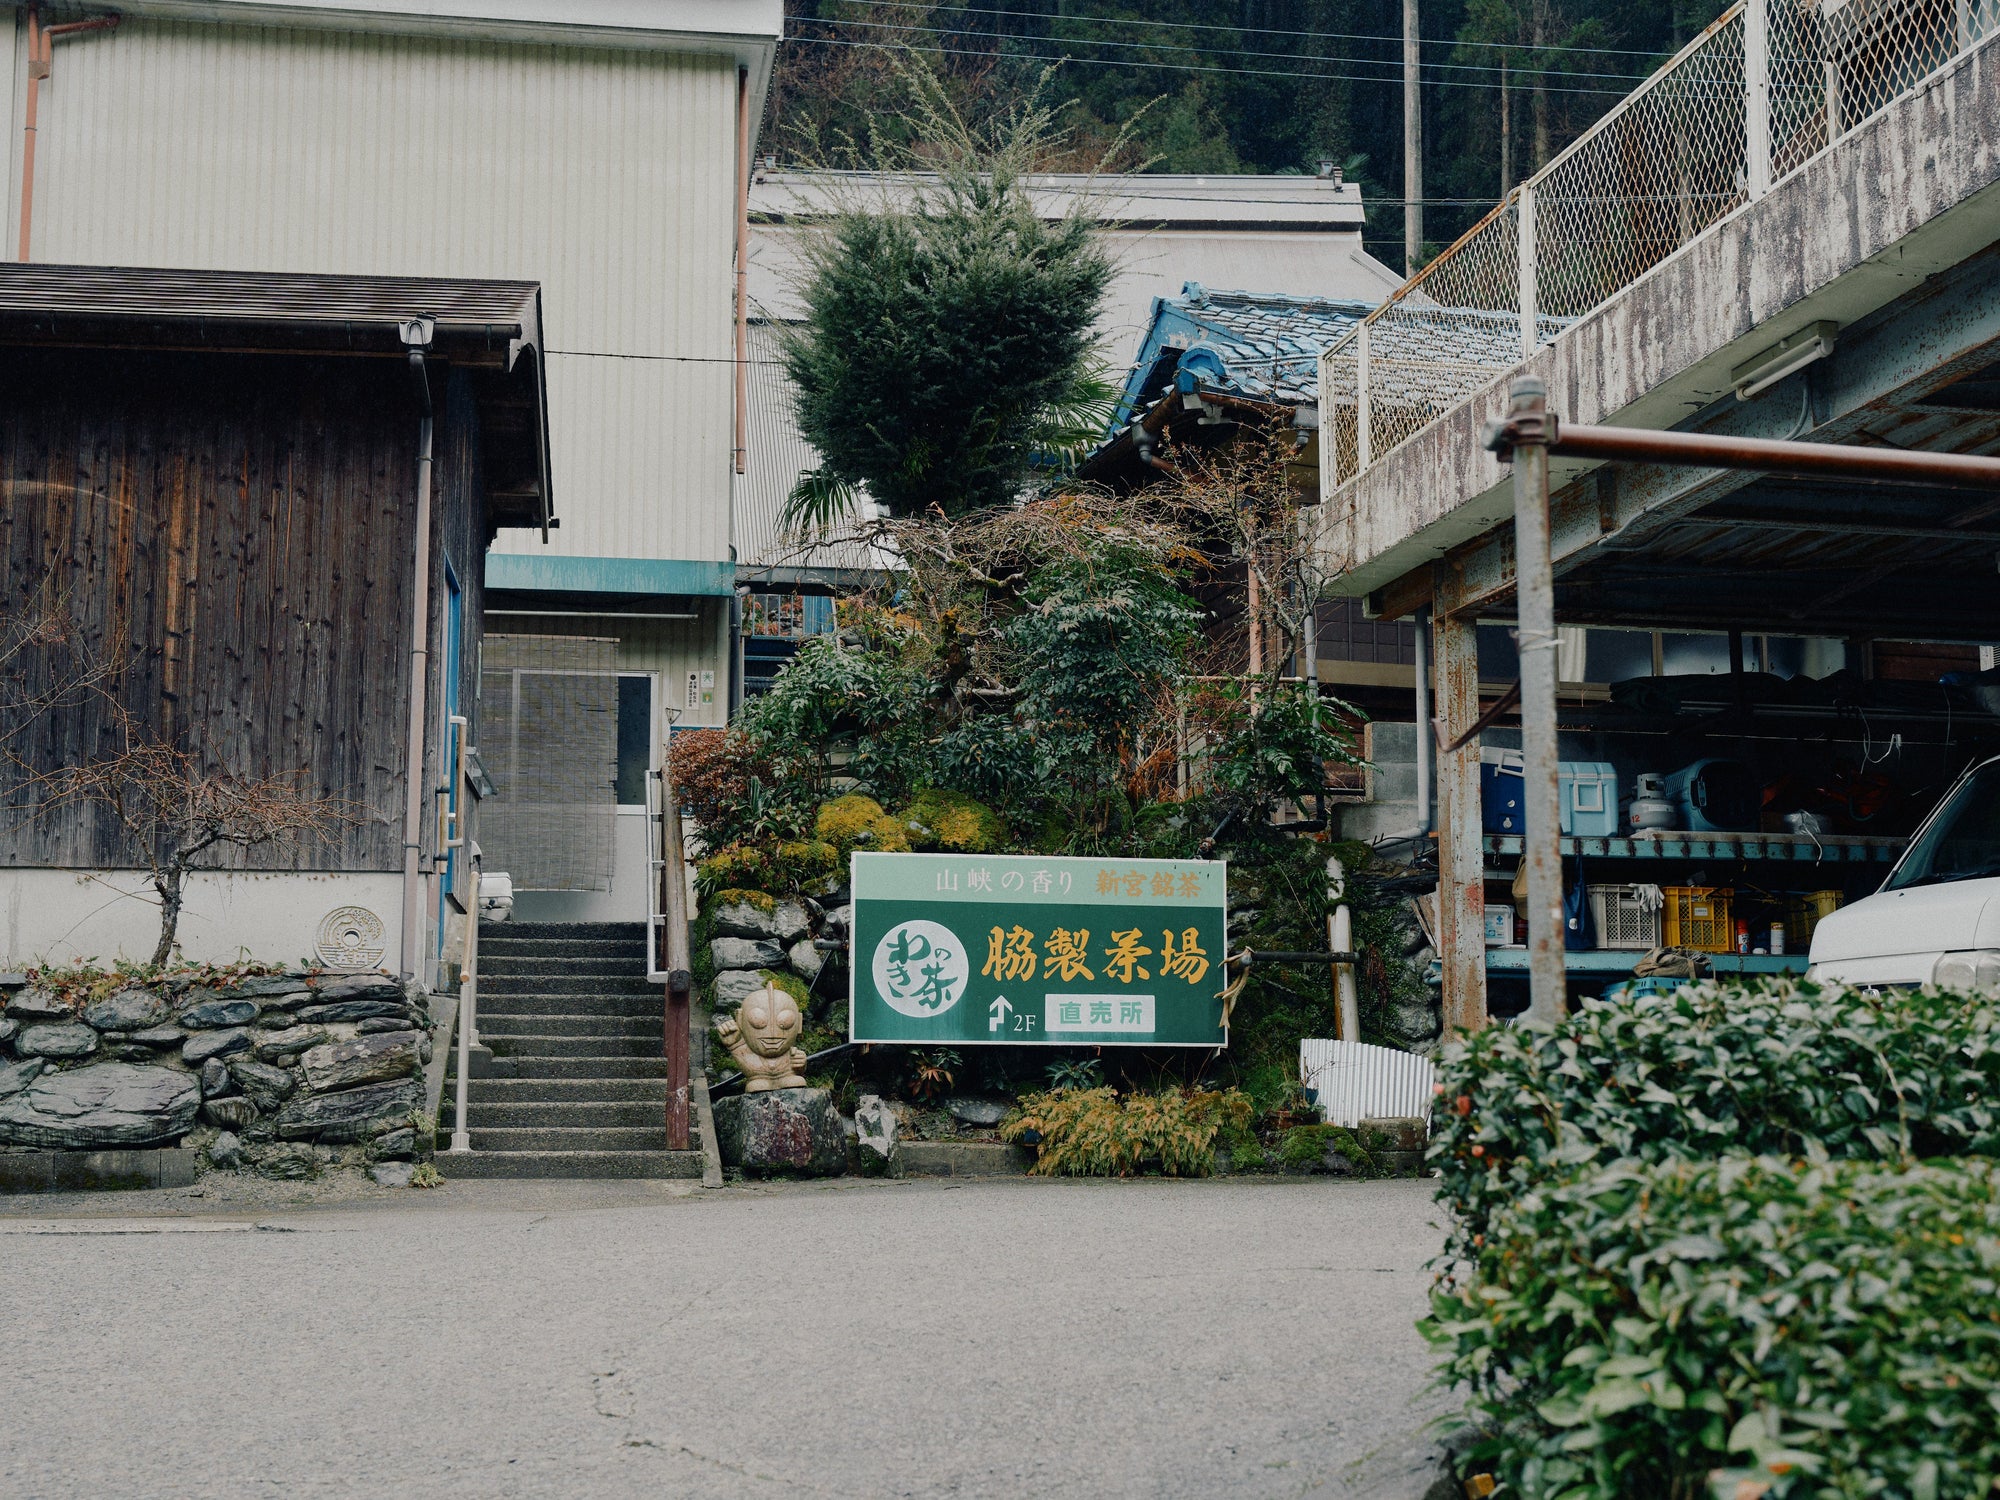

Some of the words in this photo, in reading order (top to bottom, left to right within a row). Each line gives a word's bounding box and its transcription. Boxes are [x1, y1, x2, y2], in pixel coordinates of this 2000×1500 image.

[936, 868, 1073, 895] 山峡の香り
[1096, 870, 1201, 898] 新宮銘茶
[981, 925, 1210, 985] 脇製茶場
[1013, 1015, 1036, 1032] 2F
[1059, 1001, 1143, 1025] 直売所
